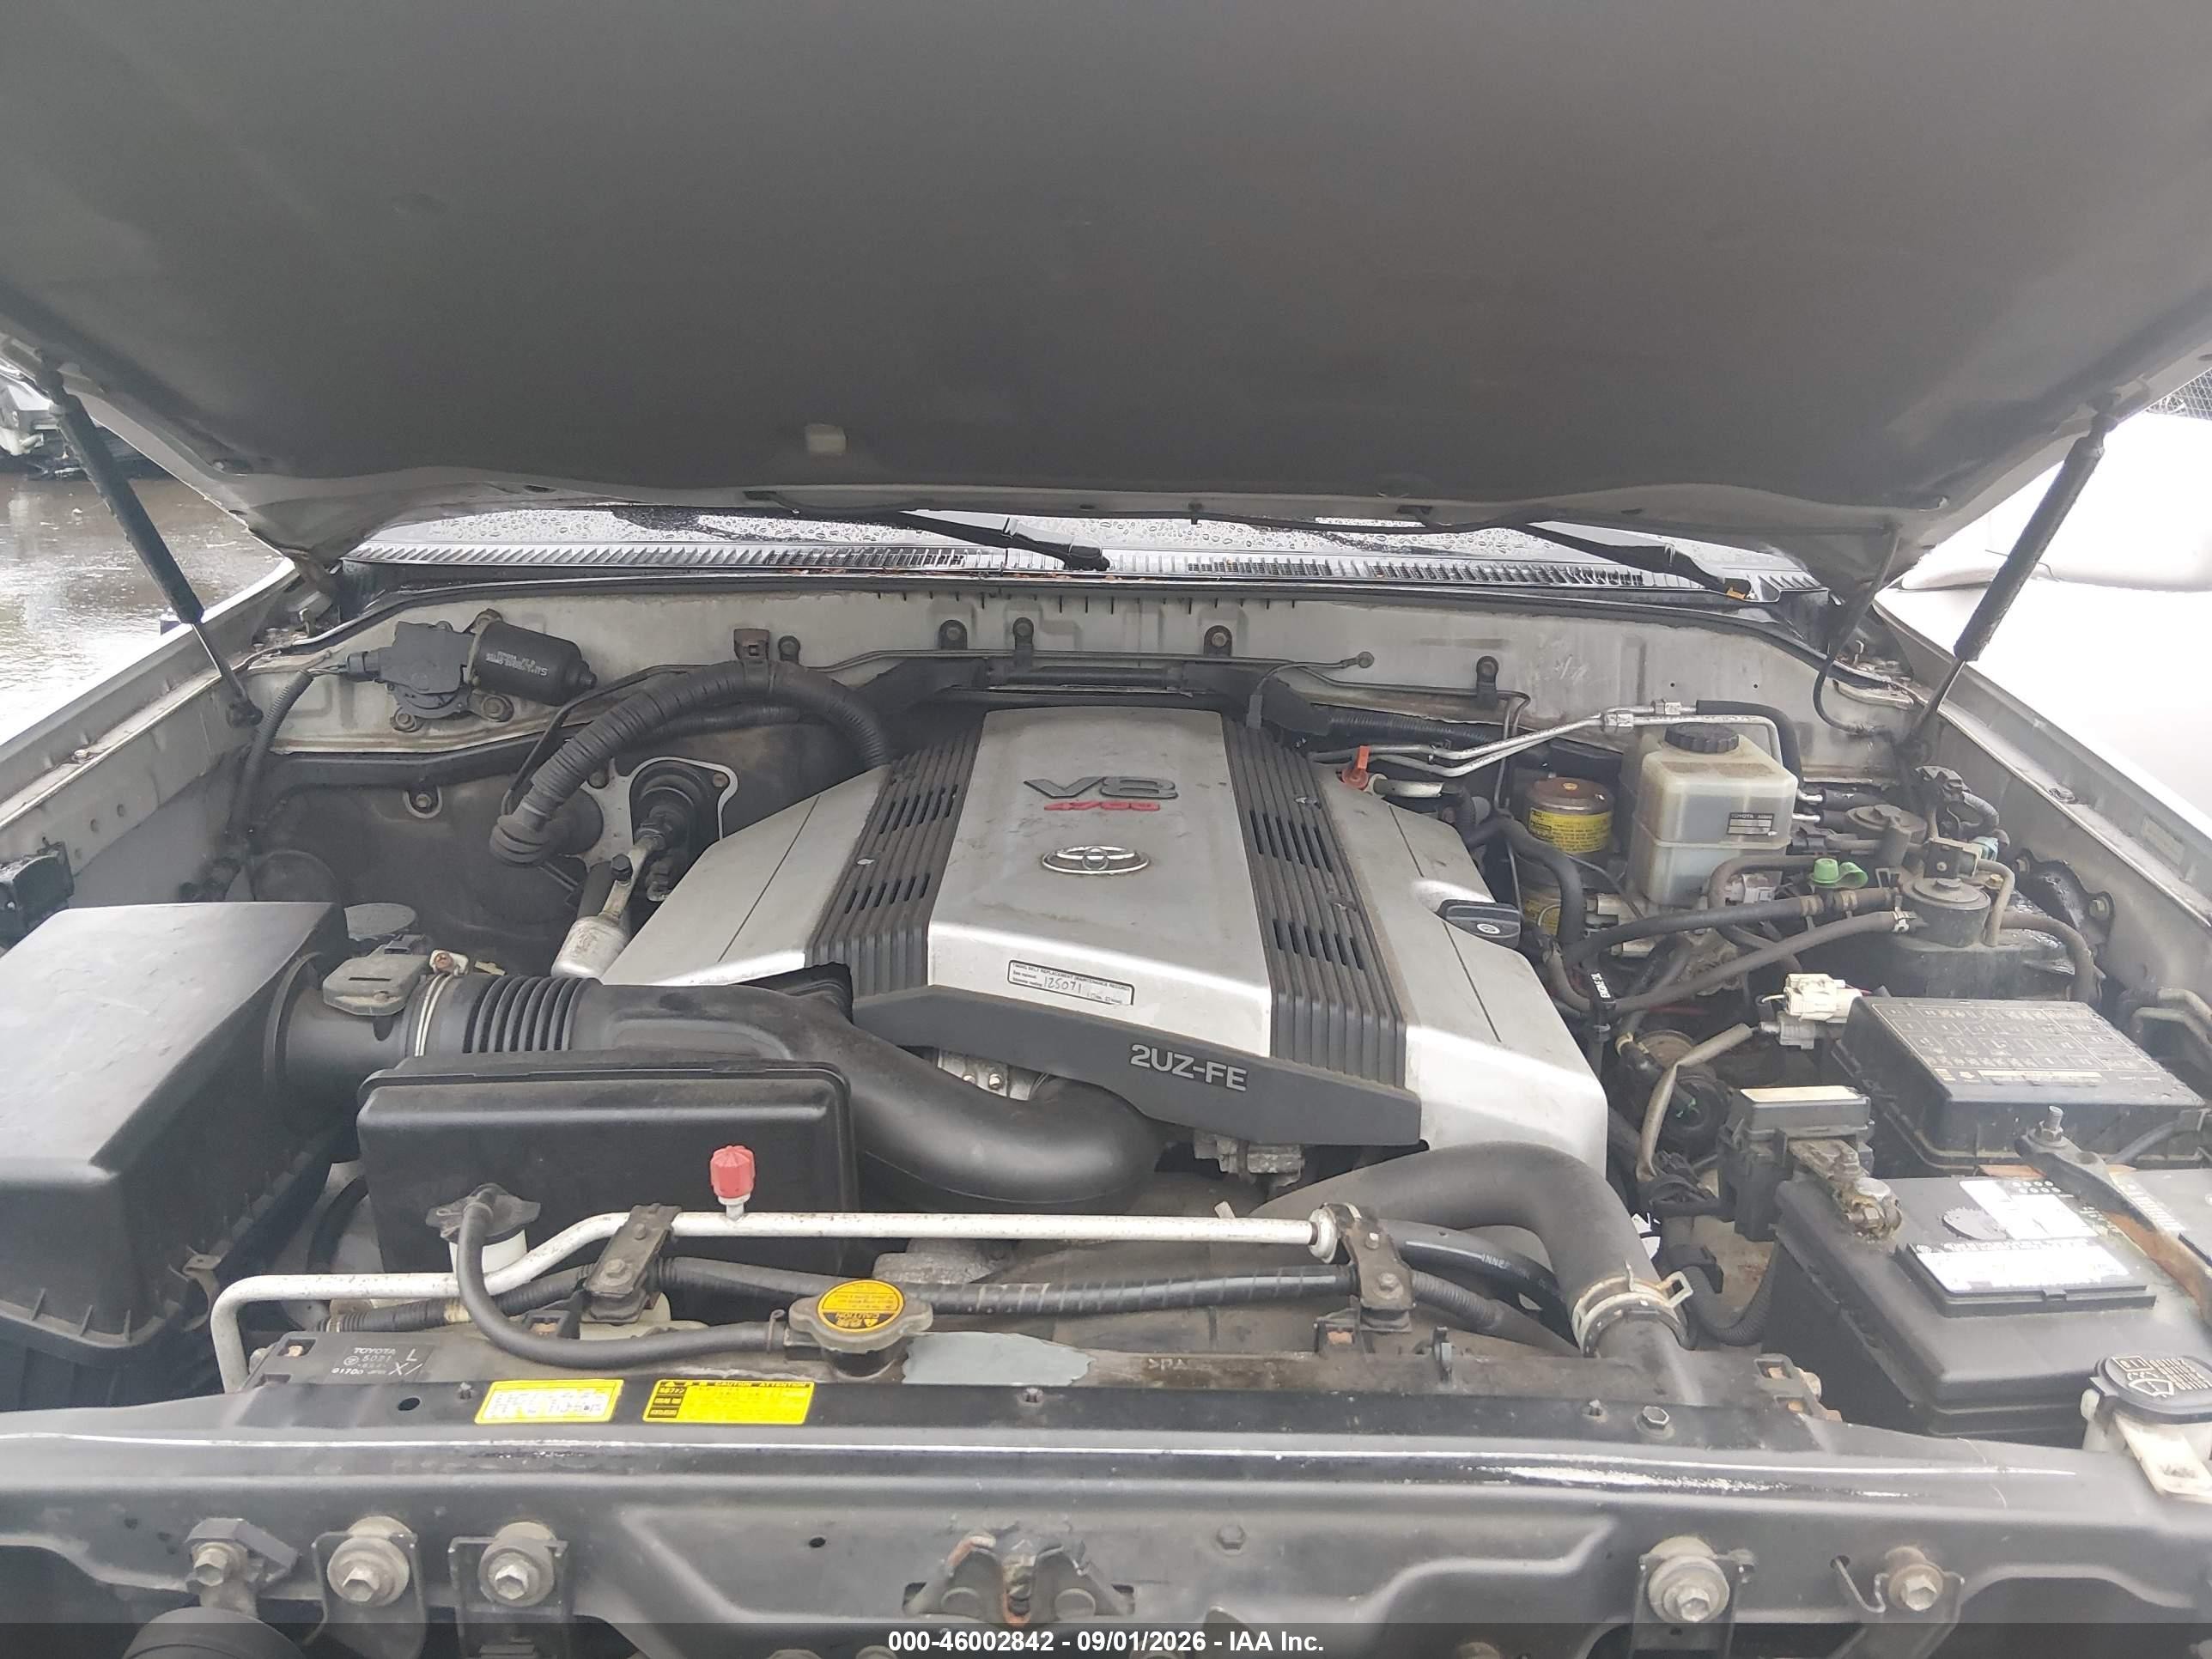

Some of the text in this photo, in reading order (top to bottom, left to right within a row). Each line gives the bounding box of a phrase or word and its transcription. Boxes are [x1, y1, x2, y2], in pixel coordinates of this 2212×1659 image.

[1023, 775, 1179, 799] V8
[1044, 975, 1082, 994] 125071
[1130, 1043, 1247, 1092] 2UZ-FE
